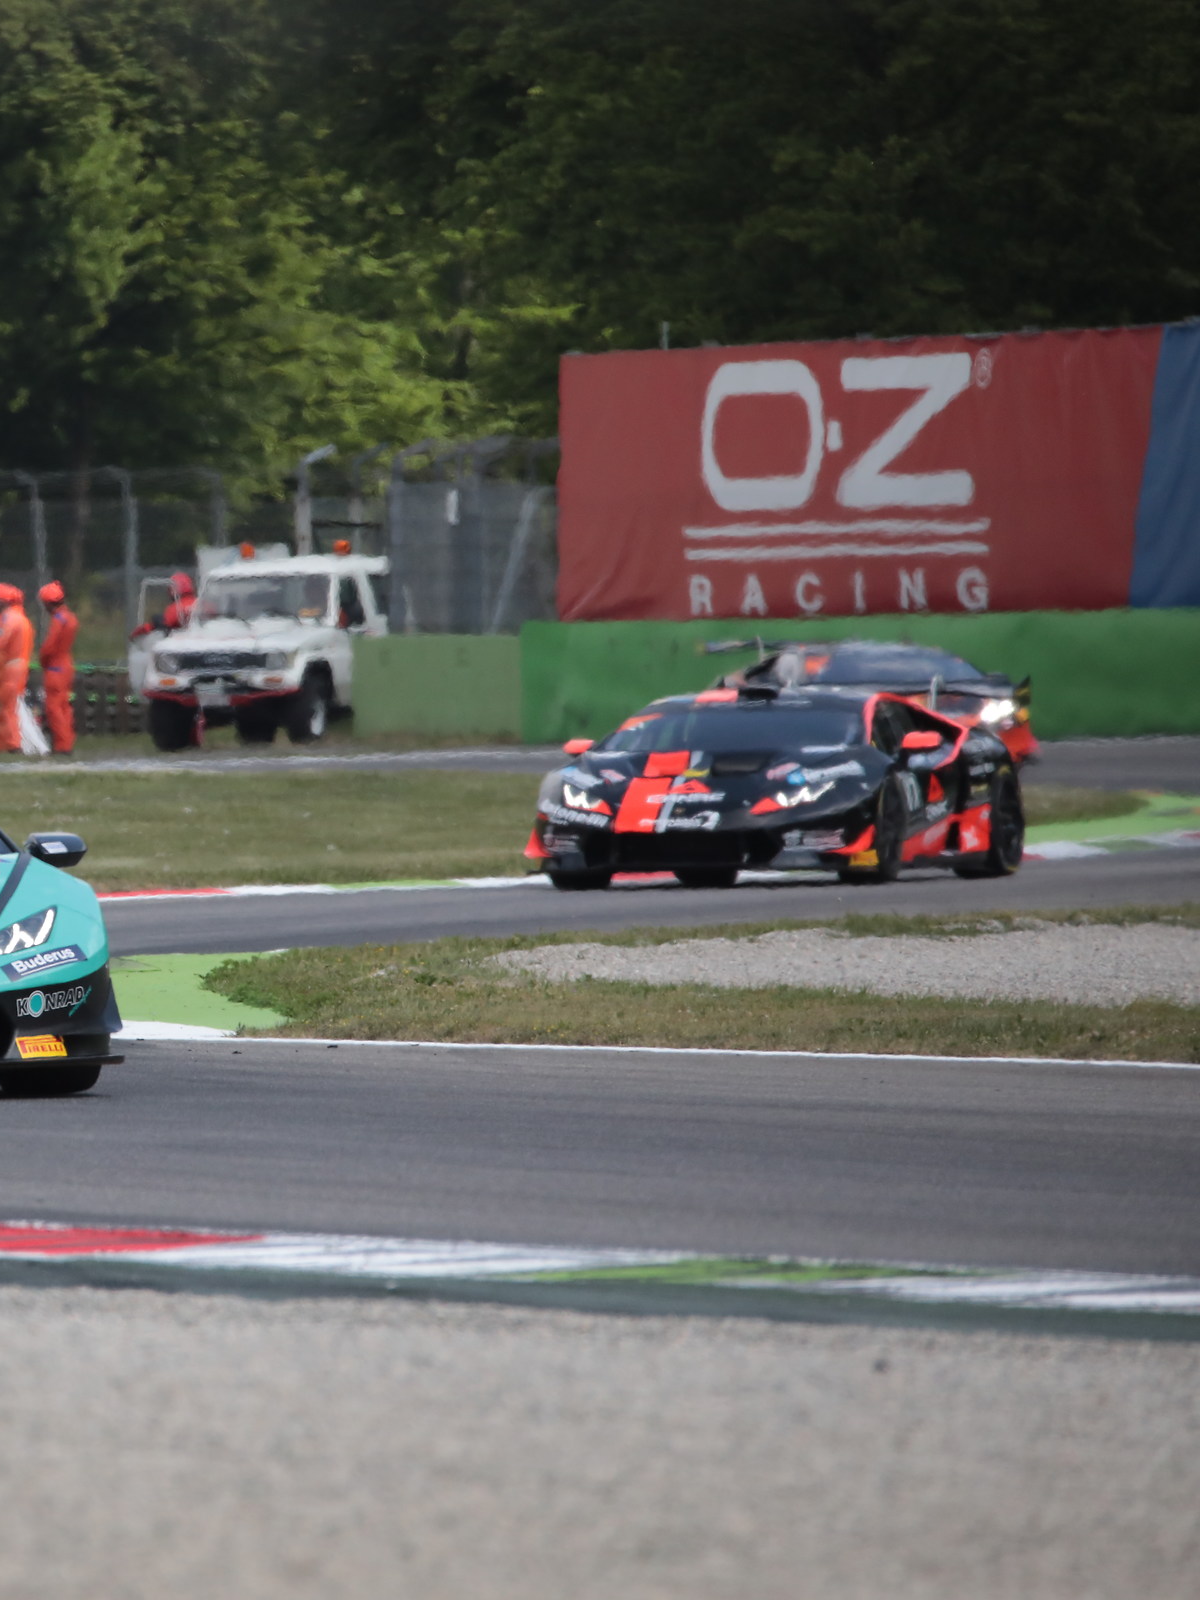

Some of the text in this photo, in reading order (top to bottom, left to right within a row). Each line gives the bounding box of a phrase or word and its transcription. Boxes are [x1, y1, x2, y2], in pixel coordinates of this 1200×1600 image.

[688, 567, 990, 615] RACING
[10, 947, 76, 974] Buderus
[16, 984, 85, 1018] KONRAD
[19, 1037, 65, 1055] PIRELLI
